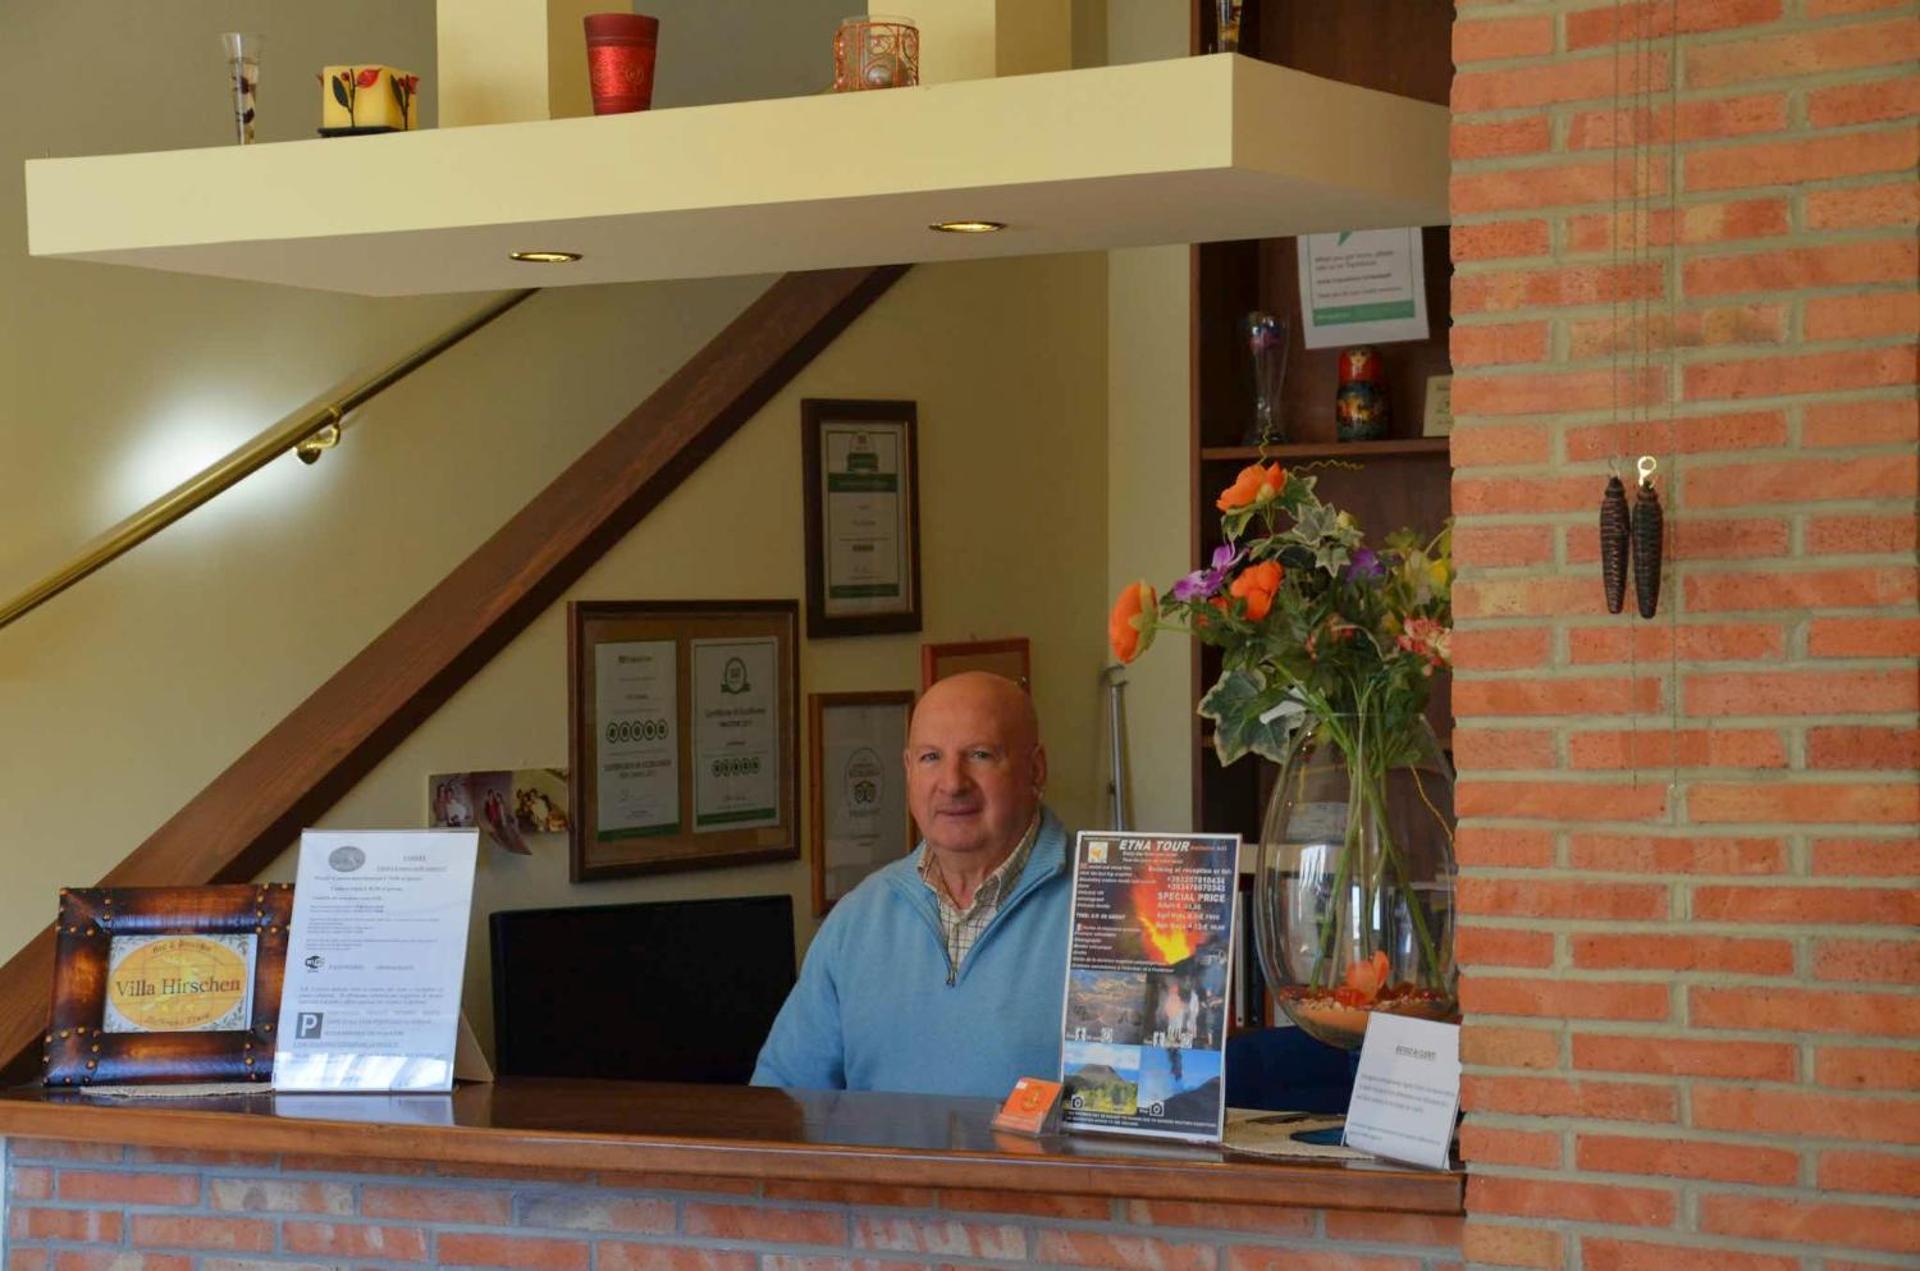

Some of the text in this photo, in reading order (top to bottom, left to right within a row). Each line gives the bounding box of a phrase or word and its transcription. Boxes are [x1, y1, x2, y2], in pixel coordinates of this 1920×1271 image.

[1119, 839, 1152, 851] ETNA
[1156, 840, 1191, 852] TOUR
[1157, 891, 1226, 903] SPECIAL PRICE
[116, 976, 241, 997] Villa Hirschen
[301, 1014, 317, 1038] P
